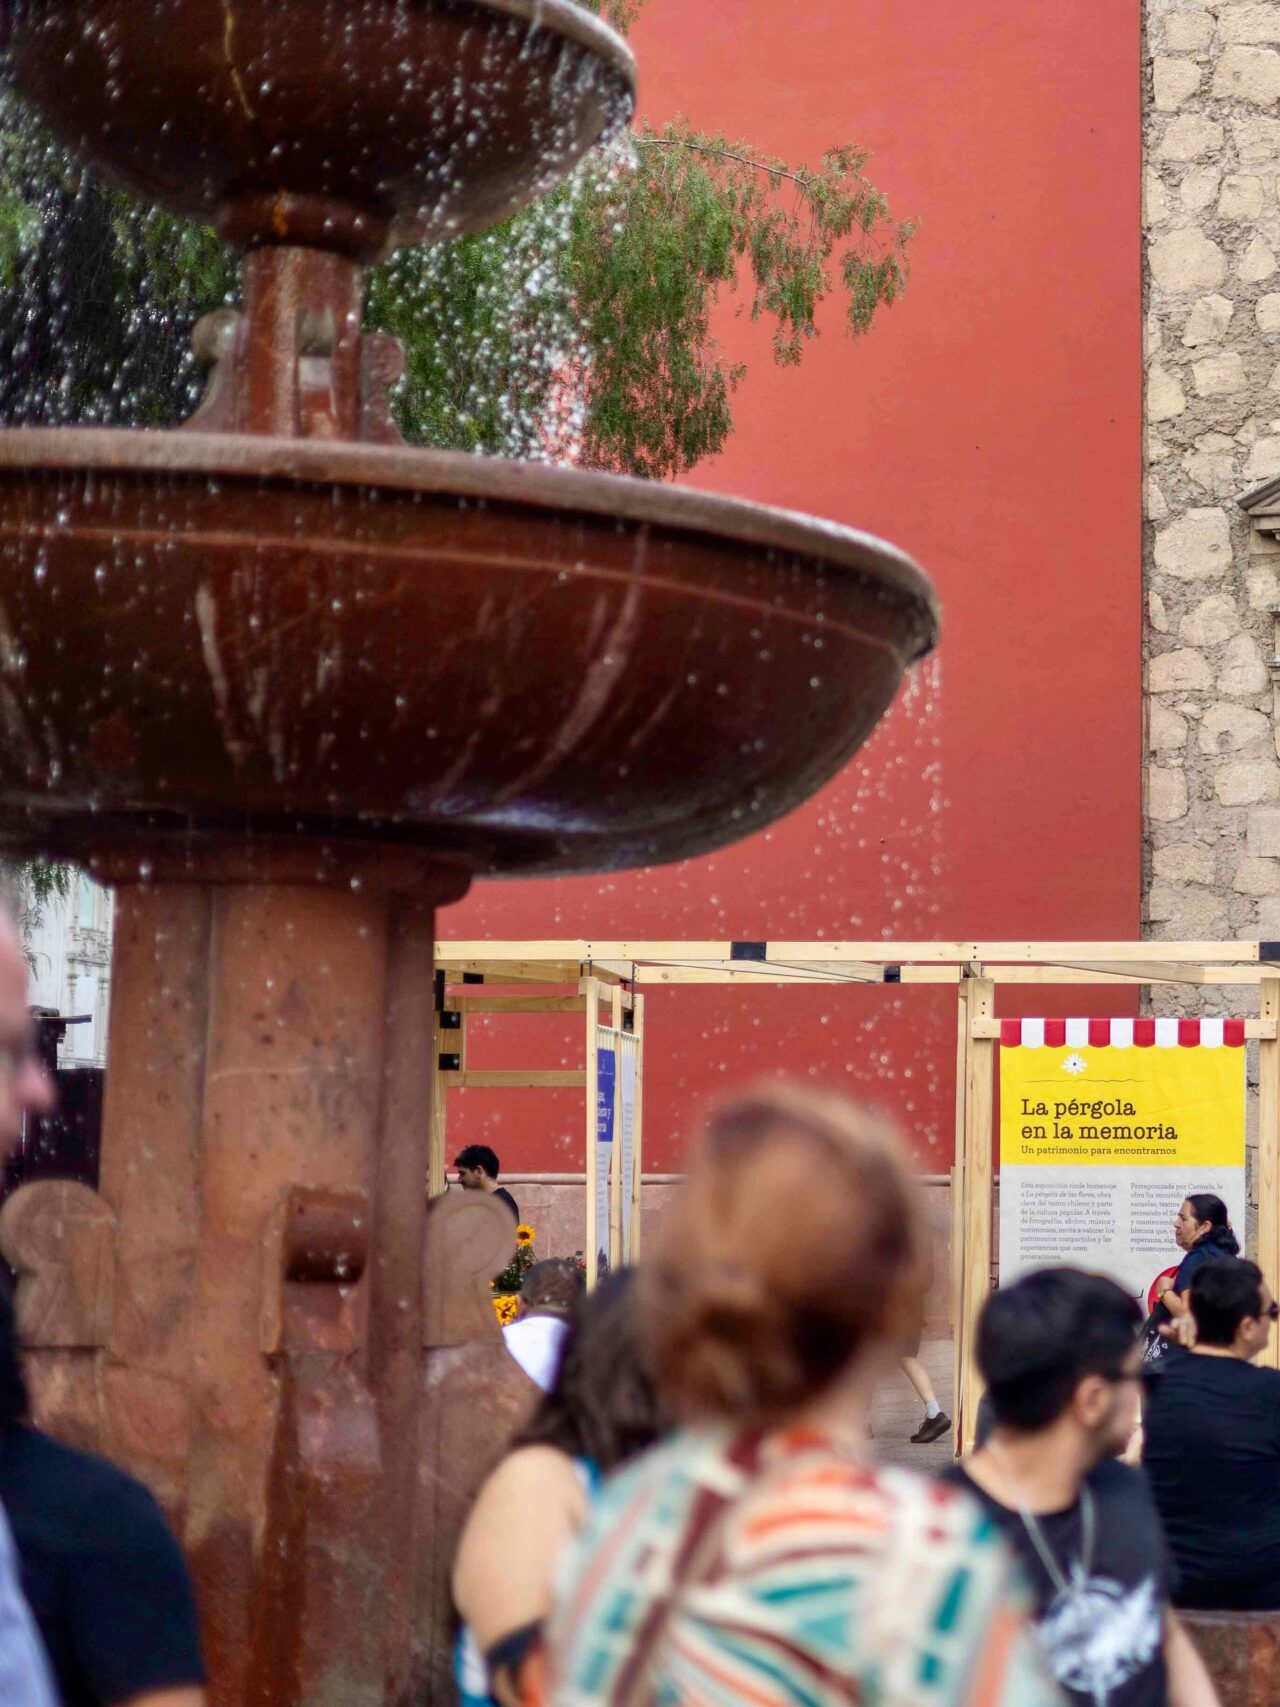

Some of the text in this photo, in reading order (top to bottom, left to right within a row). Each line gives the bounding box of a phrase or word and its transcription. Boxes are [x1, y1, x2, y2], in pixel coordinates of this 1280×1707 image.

[1021, 1099, 1136, 1119] La pérgola
[1021, 1123, 1178, 1140] en la memoria
[1021, 1145, 1176, 1156] Un patrimonio para encontrarnos
[1087, 1182, 1116, 1190] homenaje
